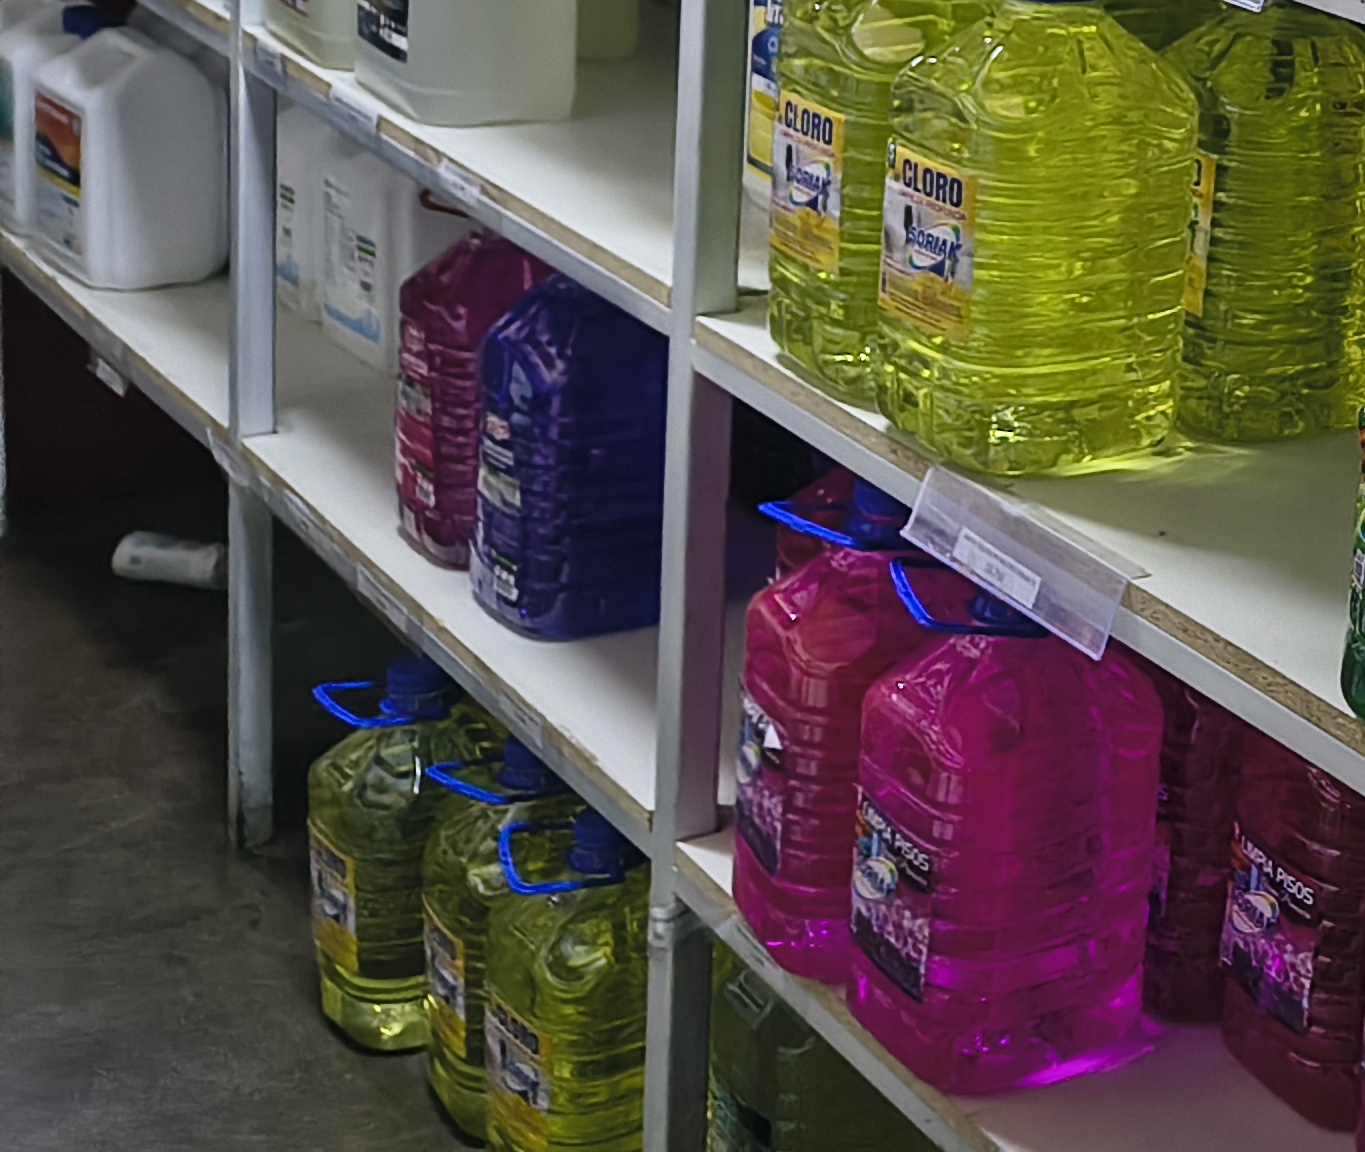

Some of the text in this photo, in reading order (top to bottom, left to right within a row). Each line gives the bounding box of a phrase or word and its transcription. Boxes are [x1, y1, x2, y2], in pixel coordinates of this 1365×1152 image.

[785, 101, 832, 145] CLORO
[903, 159, 963, 208] CLORO
[909, 224, 962, 261] SORIAK
[1241, 835, 1314, 906] LIMPIA PISOS
